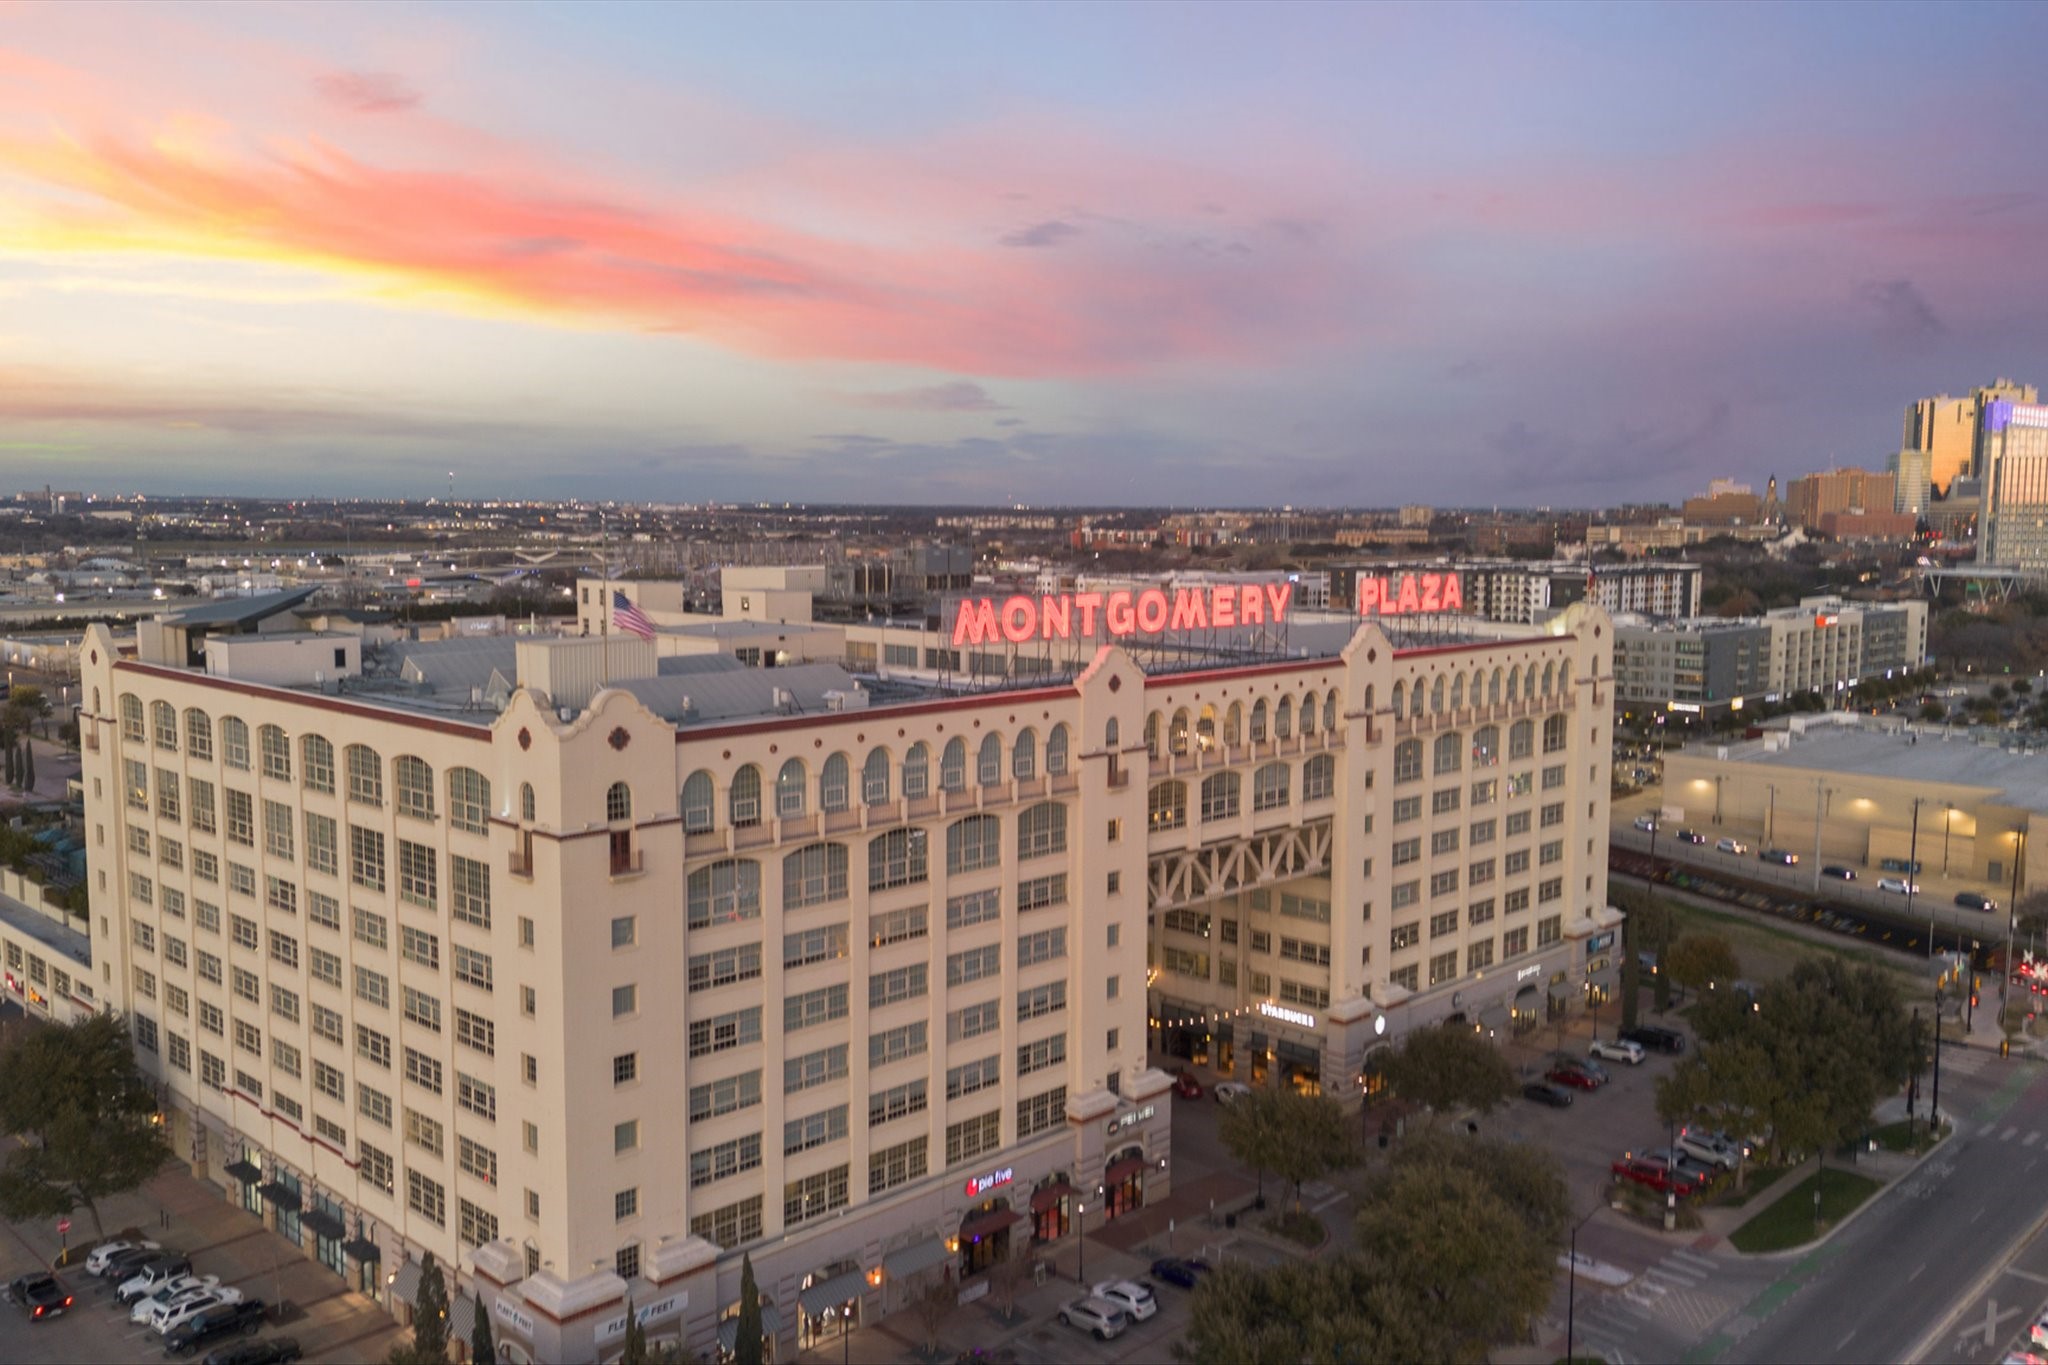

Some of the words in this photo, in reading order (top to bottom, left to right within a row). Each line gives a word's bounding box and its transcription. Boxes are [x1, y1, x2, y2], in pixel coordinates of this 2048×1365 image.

[953, 583, 1292, 645] MONTGOMERY
[1360, 573, 1464, 615] PLAZA
[1261, 1003, 1315, 1028] STARBUCKS
[1120, 1112, 1136, 1127] PEI
[651, 1299, 675, 1317] FEET
